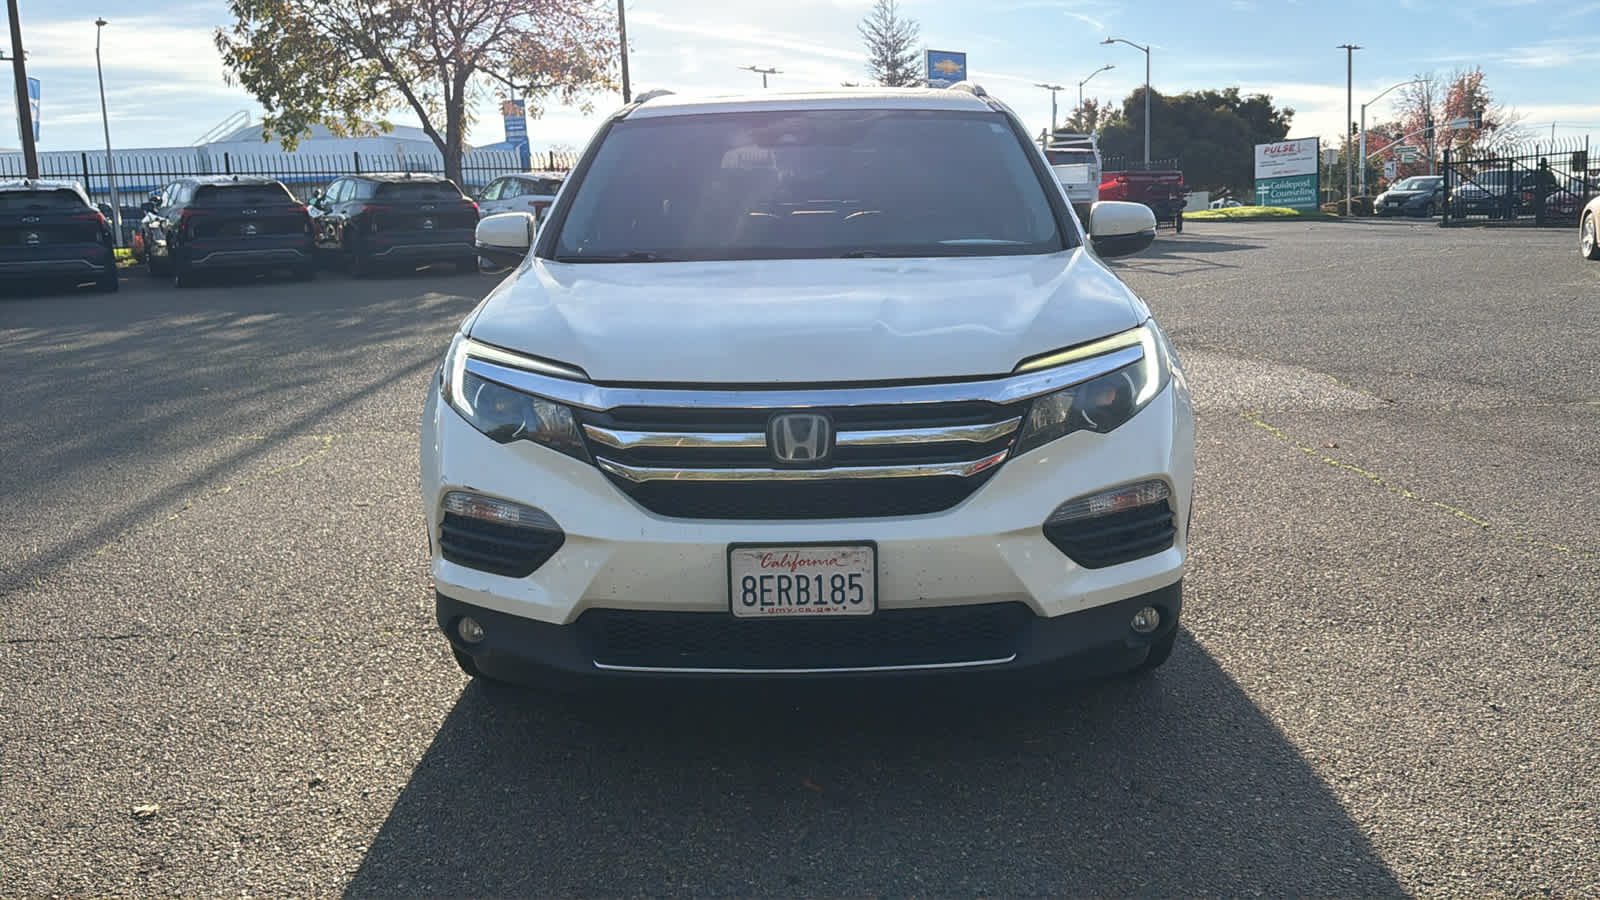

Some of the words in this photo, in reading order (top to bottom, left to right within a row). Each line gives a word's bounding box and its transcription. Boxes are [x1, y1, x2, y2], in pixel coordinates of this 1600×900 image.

[1264, 144, 1295, 153] PULSE
[1271, 179, 1310, 191] Guidepost
[1271, 189, 1316, 198] Counseling
[760, 552, 849, 572] California
[742, 573, 864, 607] 8ERB185
